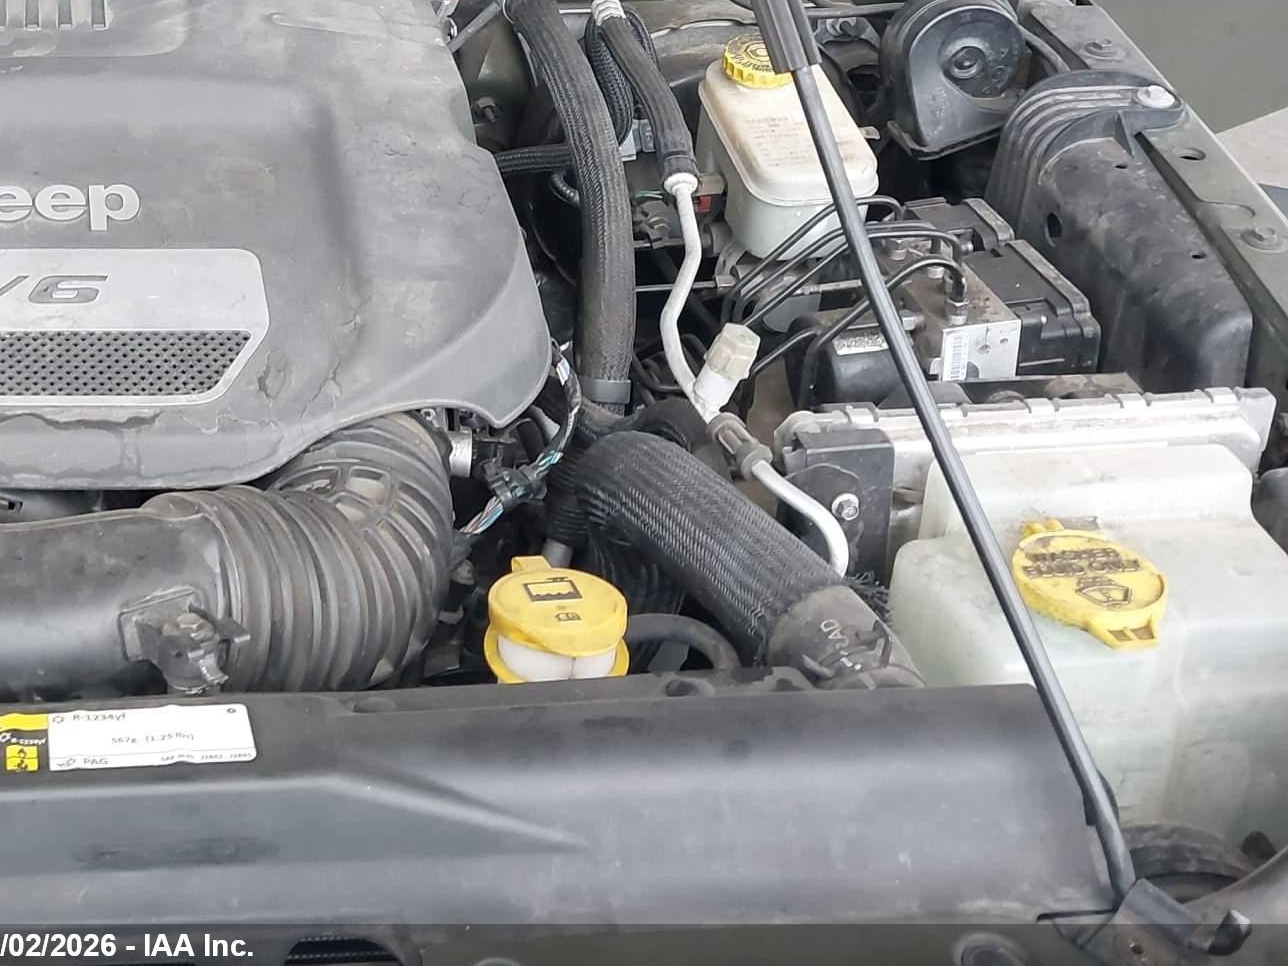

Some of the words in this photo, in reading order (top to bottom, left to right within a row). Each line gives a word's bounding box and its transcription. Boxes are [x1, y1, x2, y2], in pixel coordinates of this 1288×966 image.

[1025, 548, 1120, 563] WASHER
[1022, 561, 1086, 577] FLUID
[72, 712, 127, 722] R-1234yf
[83, 758, 109, 766] PAG
